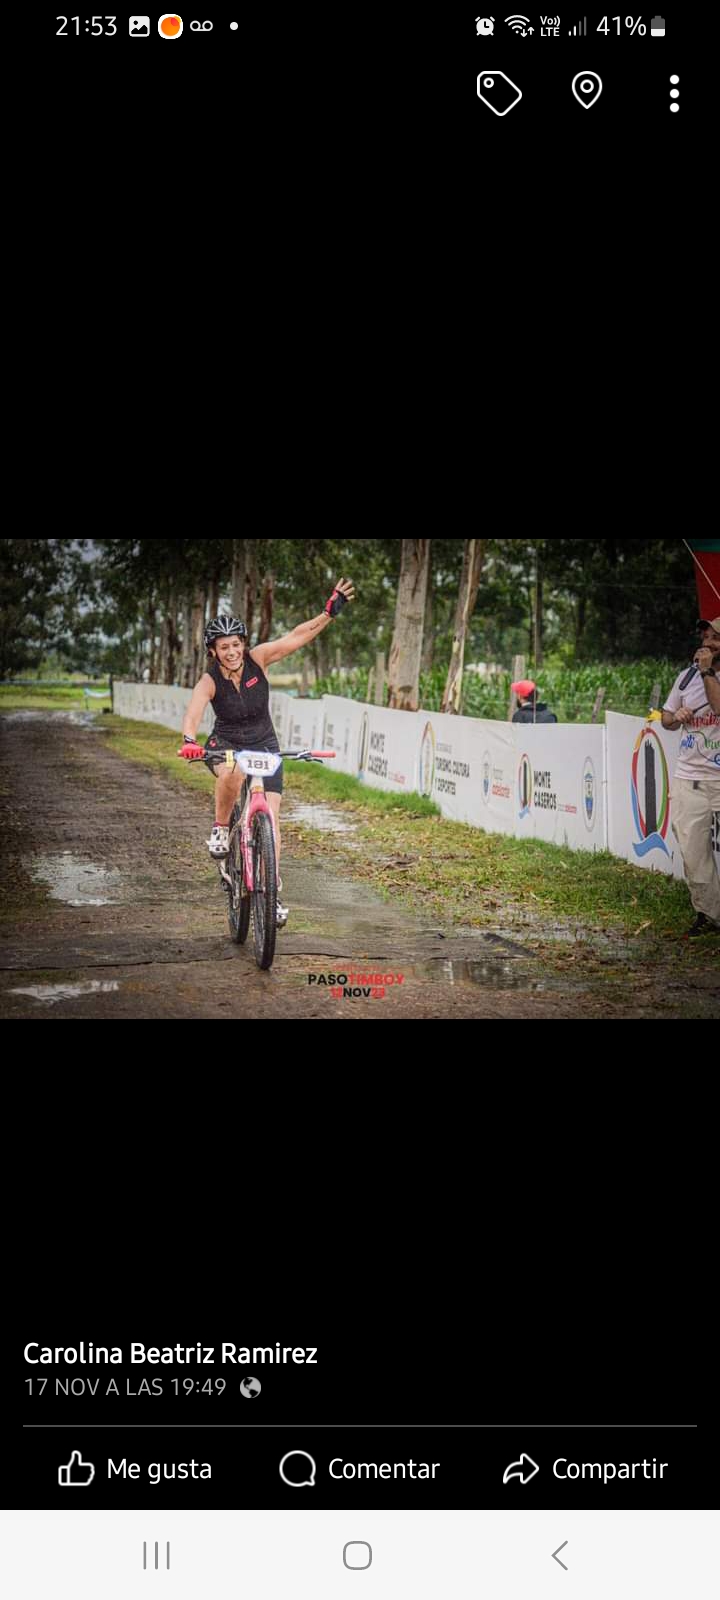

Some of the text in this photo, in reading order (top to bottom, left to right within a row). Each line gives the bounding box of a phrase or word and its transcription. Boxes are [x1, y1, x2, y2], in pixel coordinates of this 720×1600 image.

[247, 759, 269, 770] 181
[533, 770, 551, 788] MONTE
[533, 791, 557, 810] CASEROS
